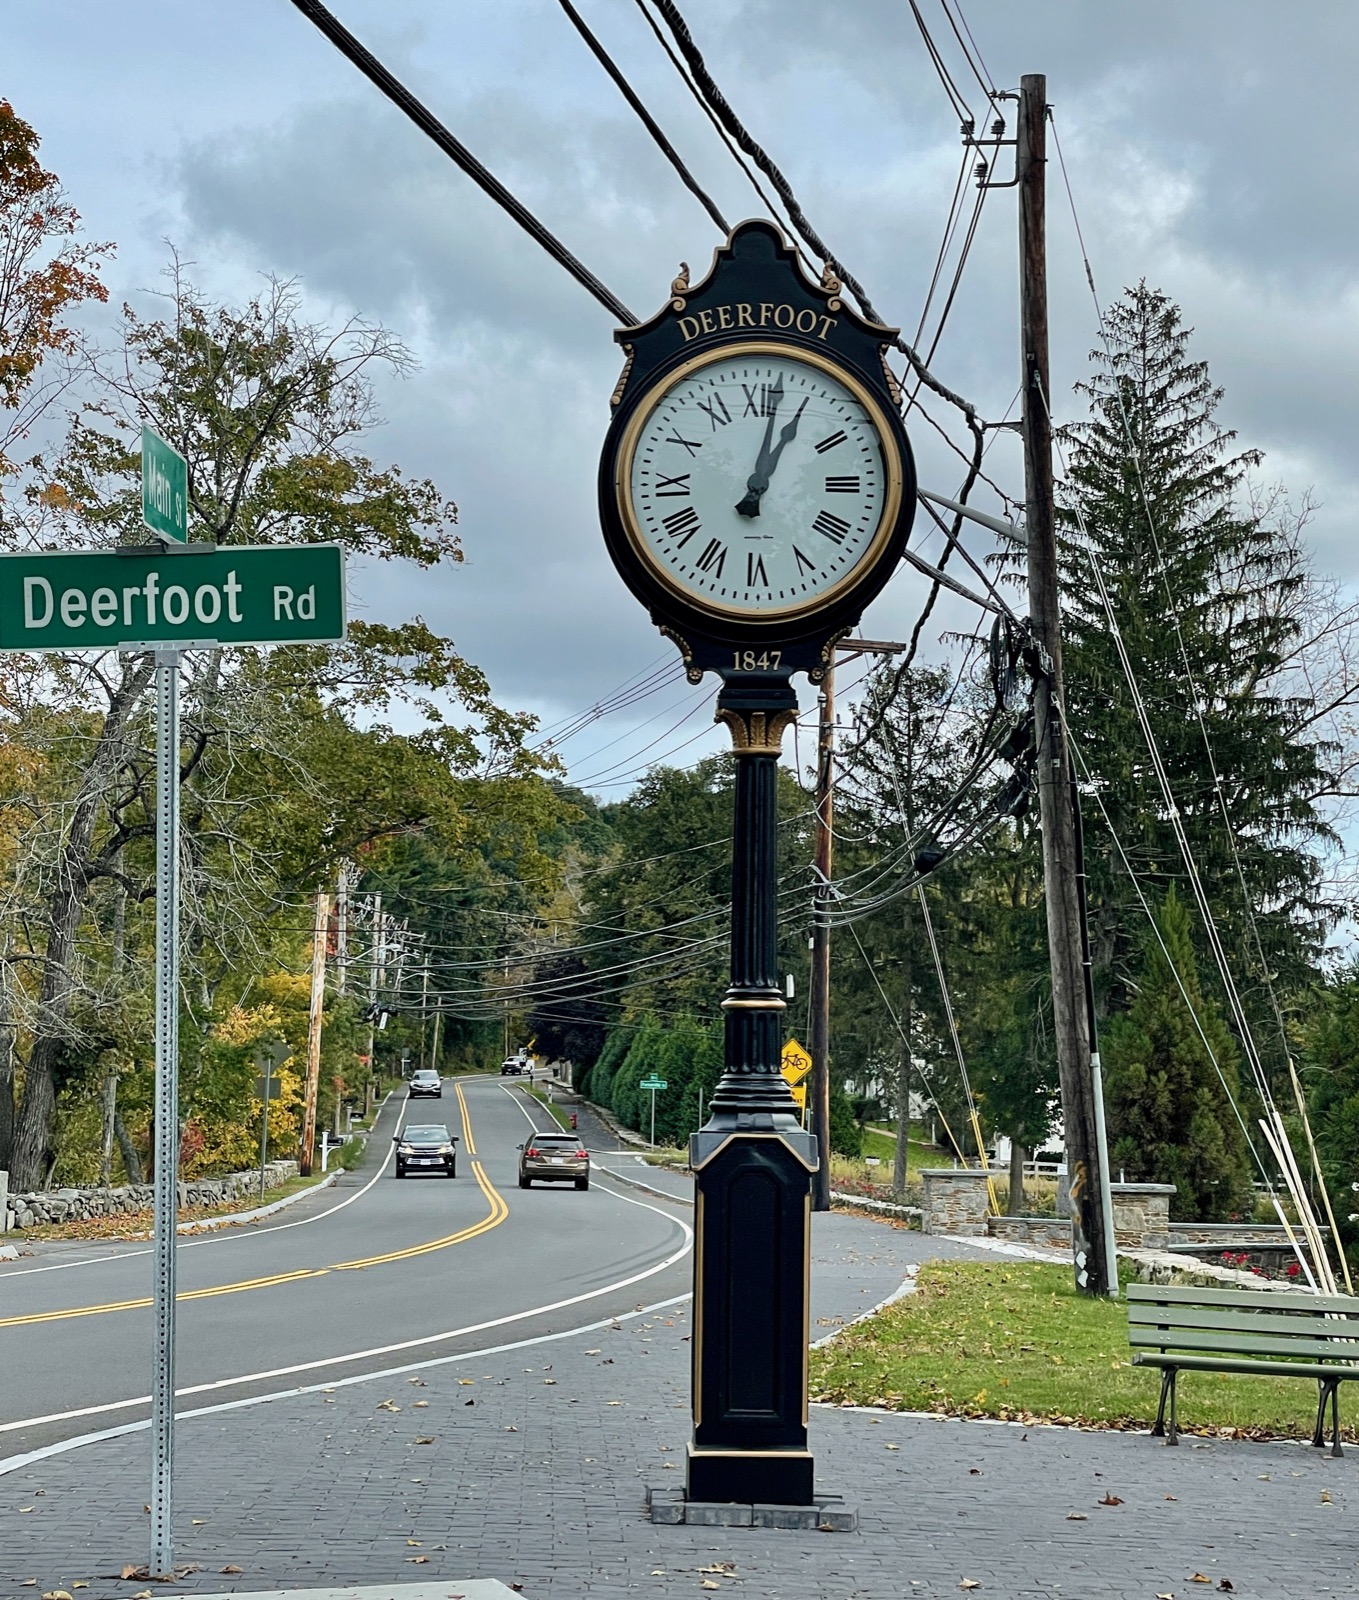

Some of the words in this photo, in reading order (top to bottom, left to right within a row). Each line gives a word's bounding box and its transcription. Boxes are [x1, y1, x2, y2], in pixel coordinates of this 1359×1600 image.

[676, 303, 838, 342] DEERFOOT
[696, 391, 732, 432] XI
[666, 427, 703, 458] X
[814, 429, 849, 455] II
[148, 452, 172, 520] Main
[175, 491, 183, 529] St
[655, 472, 691, 498] IX
[825, 475, 861, 494] III
[661, 505, 703, 550] VIII
[811, 509, 852, 546] IIII
[695, 537, 729, 579] VII
[747, 552, 770, 587] VI
[792, 543, 817, 577] V
[23, 570, 243, 629] Deerfoot
[273, 584, 316, 621] Rd
[732, 650, 782, 671] 1847
